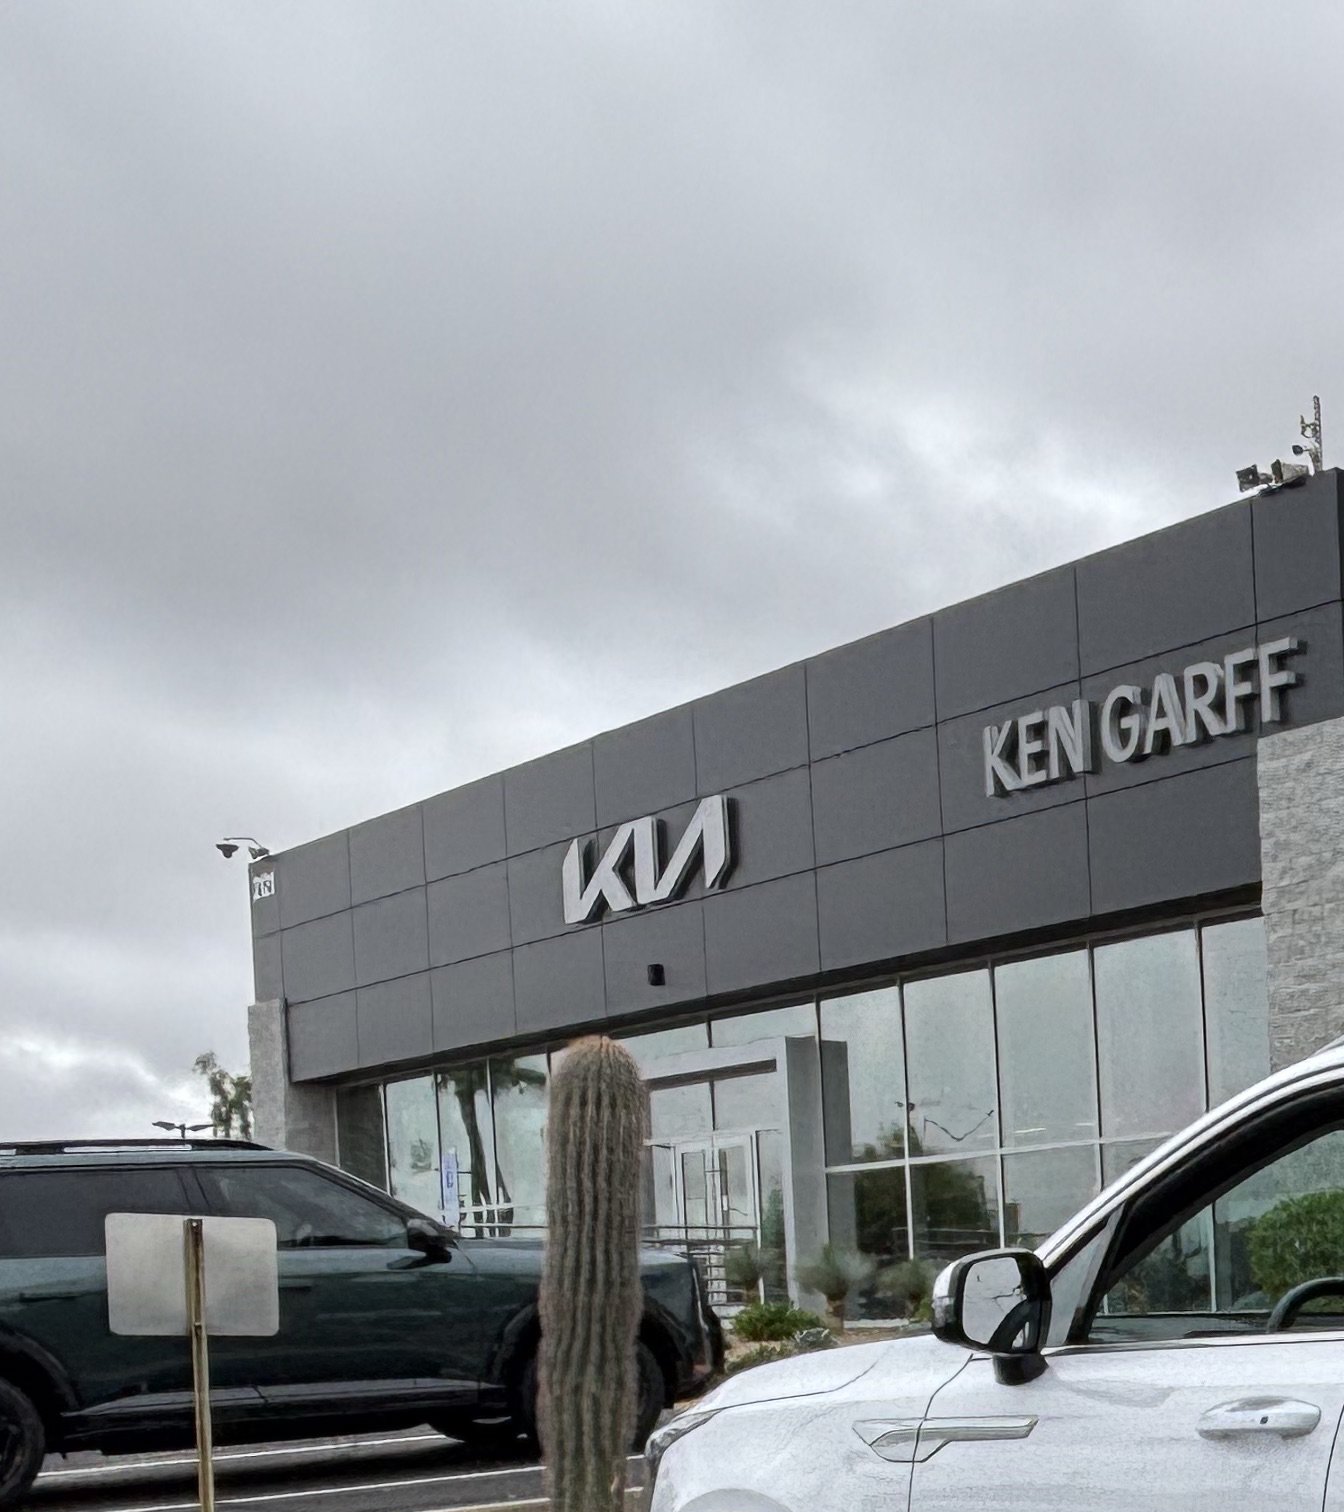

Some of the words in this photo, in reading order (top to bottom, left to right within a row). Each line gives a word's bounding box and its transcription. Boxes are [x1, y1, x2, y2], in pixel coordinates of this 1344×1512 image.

[983, 699, 1092, 798] KEN
[1101, 637, 1299, 763] GARFF
[562, 794, 731, 925] KIA
